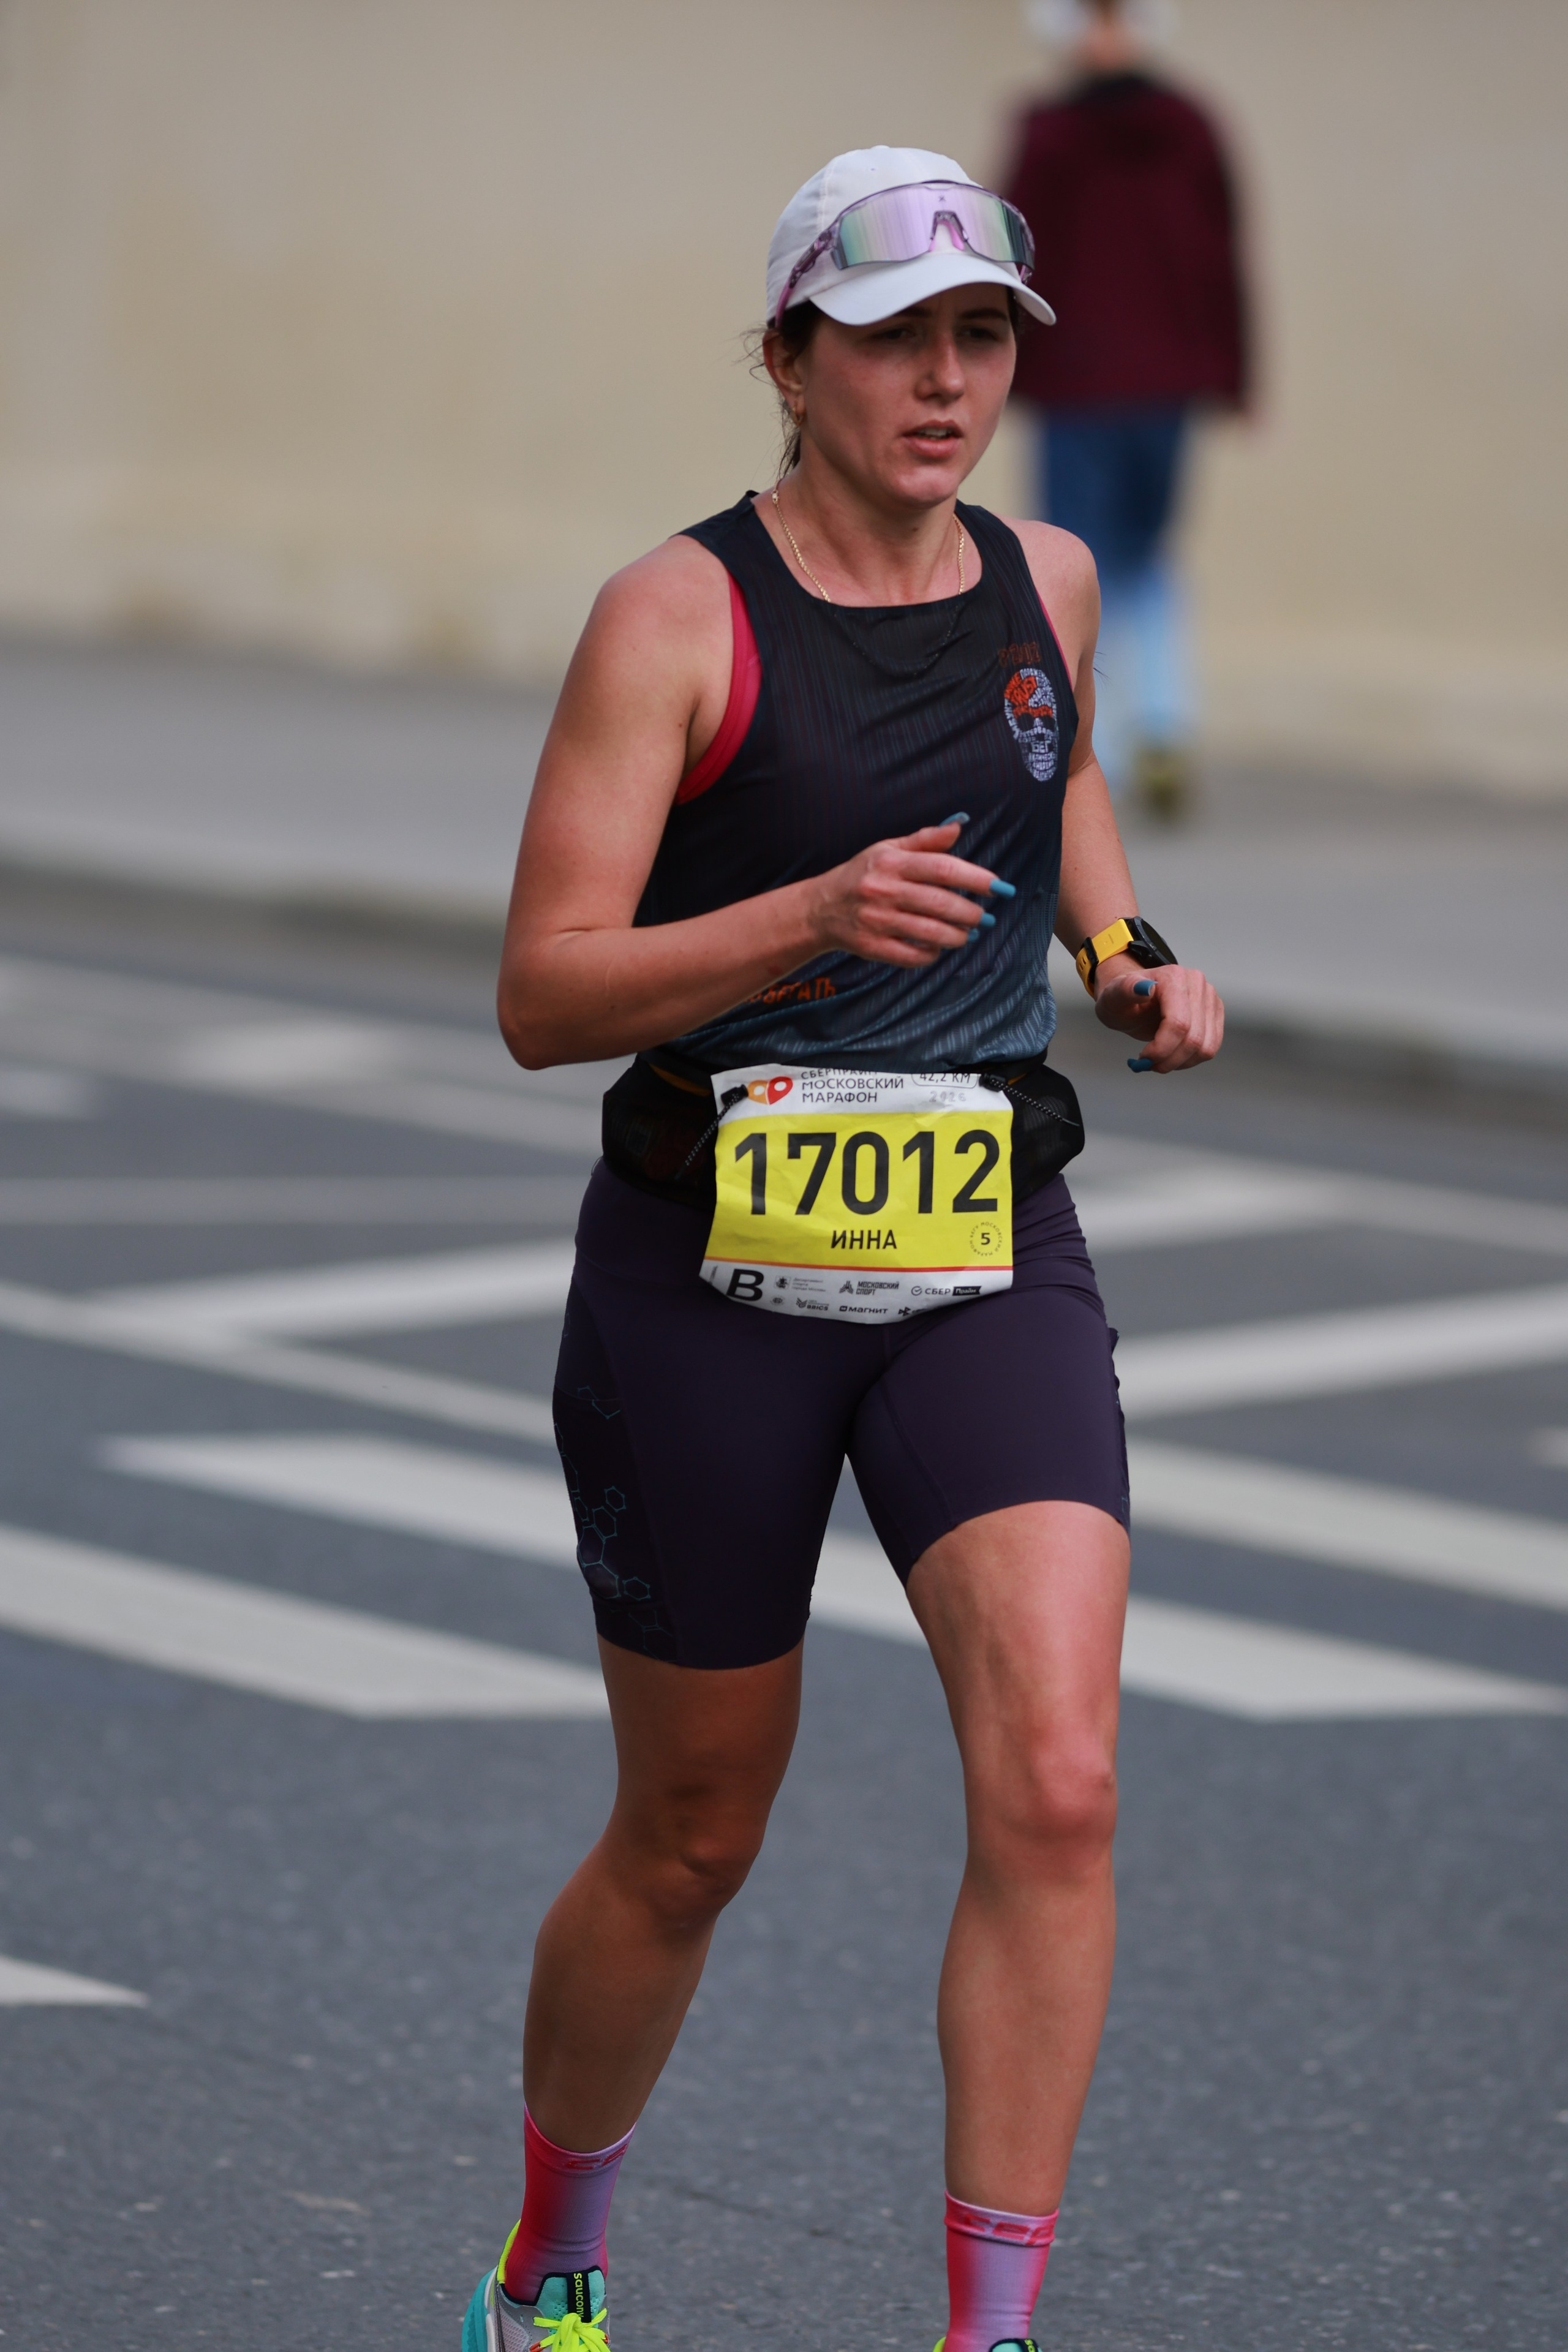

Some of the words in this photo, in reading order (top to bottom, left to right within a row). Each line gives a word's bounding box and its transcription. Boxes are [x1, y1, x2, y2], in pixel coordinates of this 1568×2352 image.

[802, 1076, 904, 1090] МОСКОВСКИЙ
[802, 1091, 878, 1103] МАРАФОН
[735, 1129, 1000, 1215] 17012
[831, 1229, 897, 1250] ИННА
[981, 1232, 990, 1245] 5
[858, 1281, 899, 1289] МОСКОВСКИЙ
[573, 2272, 584, 2318] saucony
